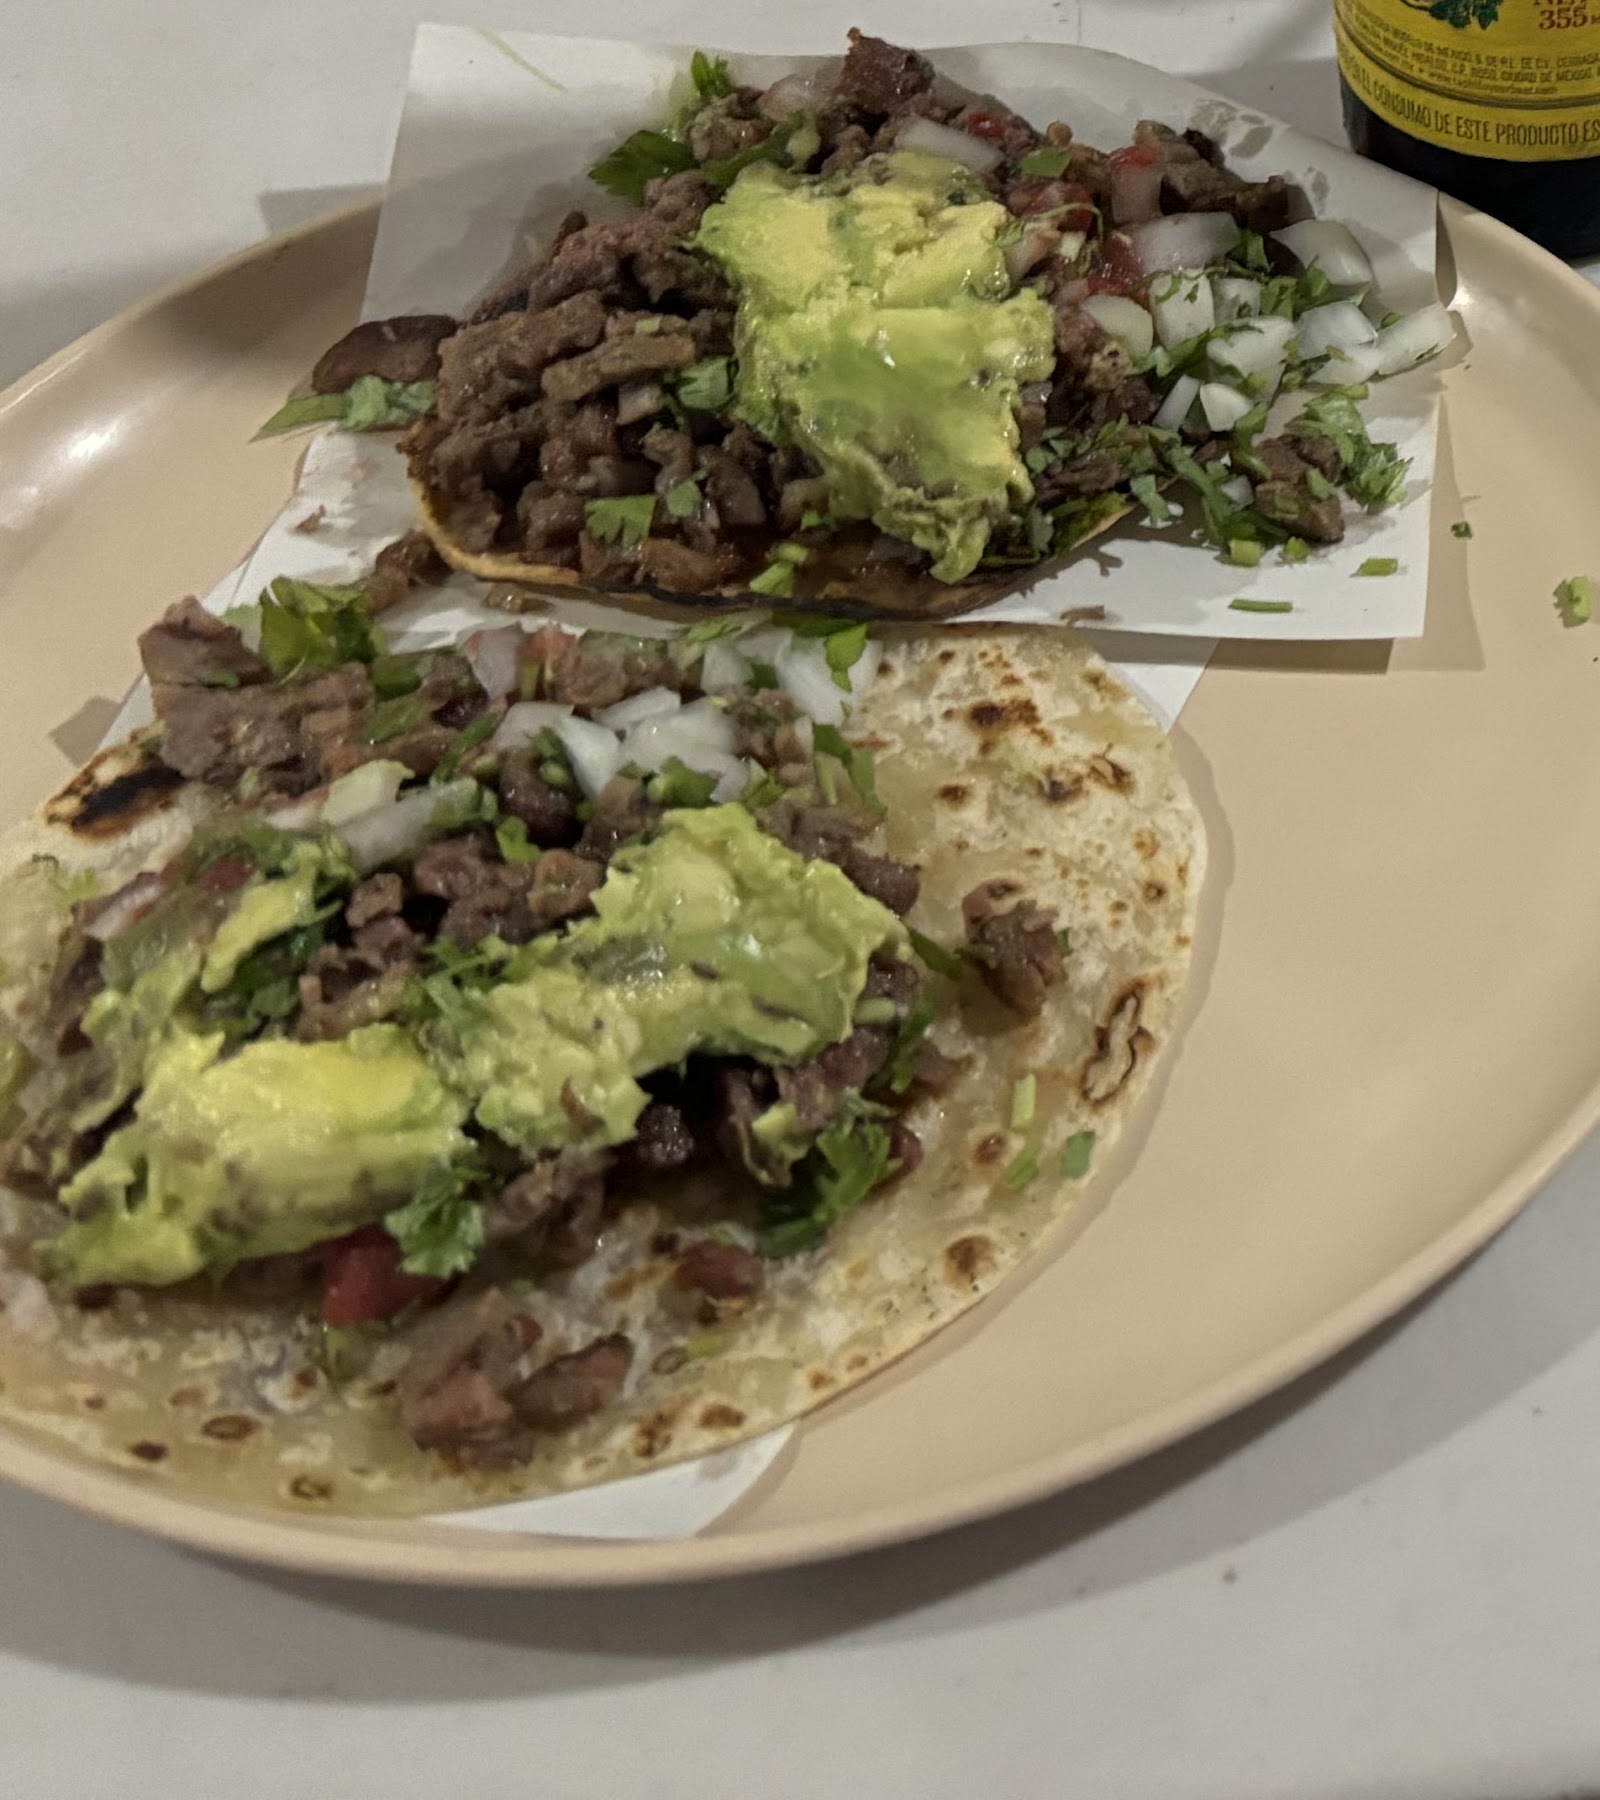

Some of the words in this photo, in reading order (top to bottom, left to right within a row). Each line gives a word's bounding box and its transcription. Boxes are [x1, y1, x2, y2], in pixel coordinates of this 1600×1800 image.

[1434, 110, 1453, 135] DE
[1456, 115, 1492, 143] ESTE
[1495, 122, 1580, 147] PRODUCTO
[1582, 119, 1600, 143] ES
